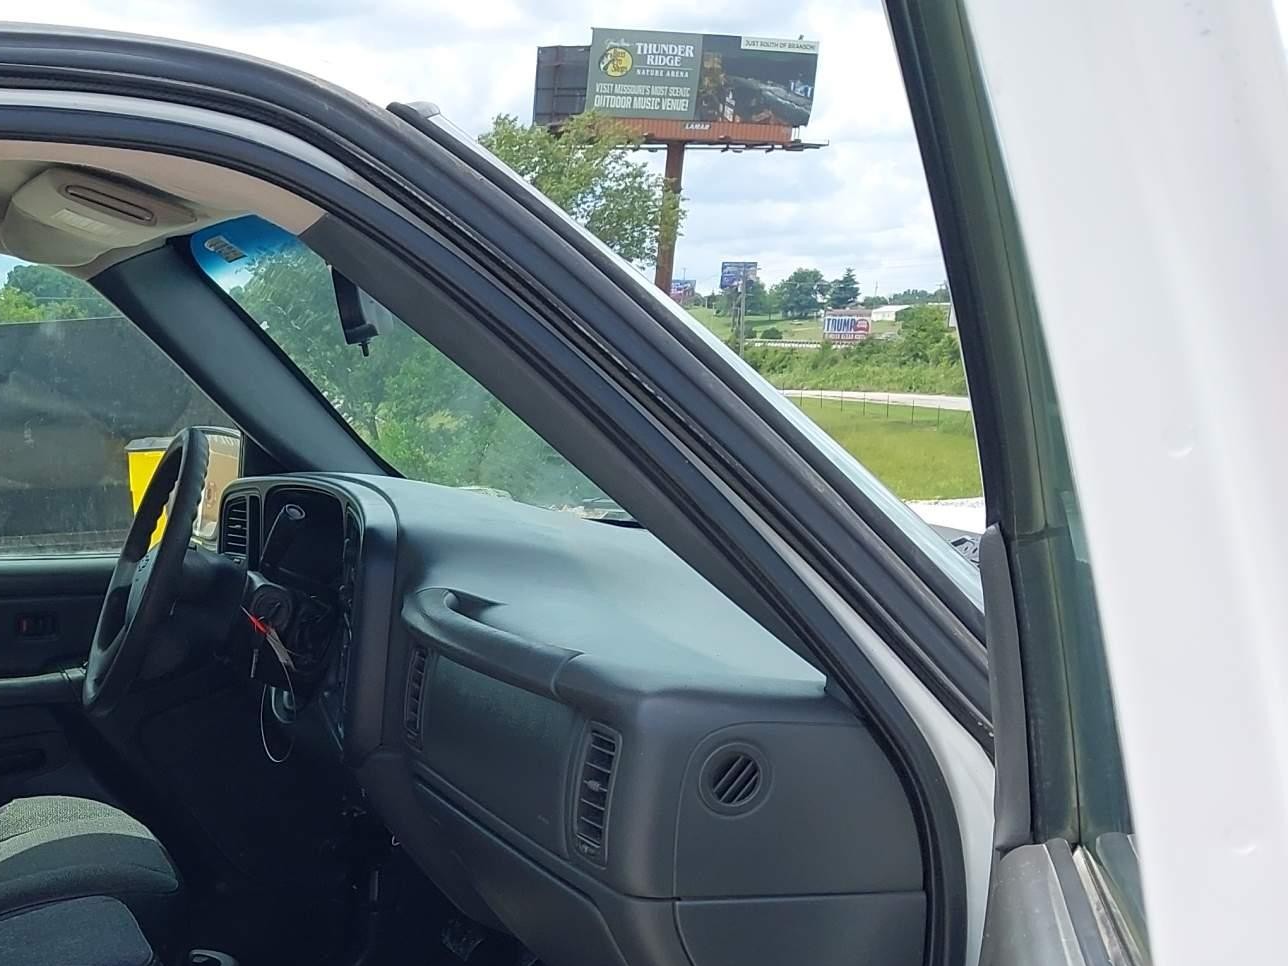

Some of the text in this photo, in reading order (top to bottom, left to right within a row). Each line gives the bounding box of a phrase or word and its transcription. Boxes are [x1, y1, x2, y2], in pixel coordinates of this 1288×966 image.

[636, 42, 694, 57] THUNDER
[647, 54, 681, 67] RIDGE
[637, 69, 689, 78] NATURE ARENA
[595, 83, 613, 94] VISIT
[652, 85, 668, 96] MOST
[669, 86, 691, 97] SCENIC
[594, 94, 631, 109] OUTDOOR
[633, 96, 660, 110] MUSIC
